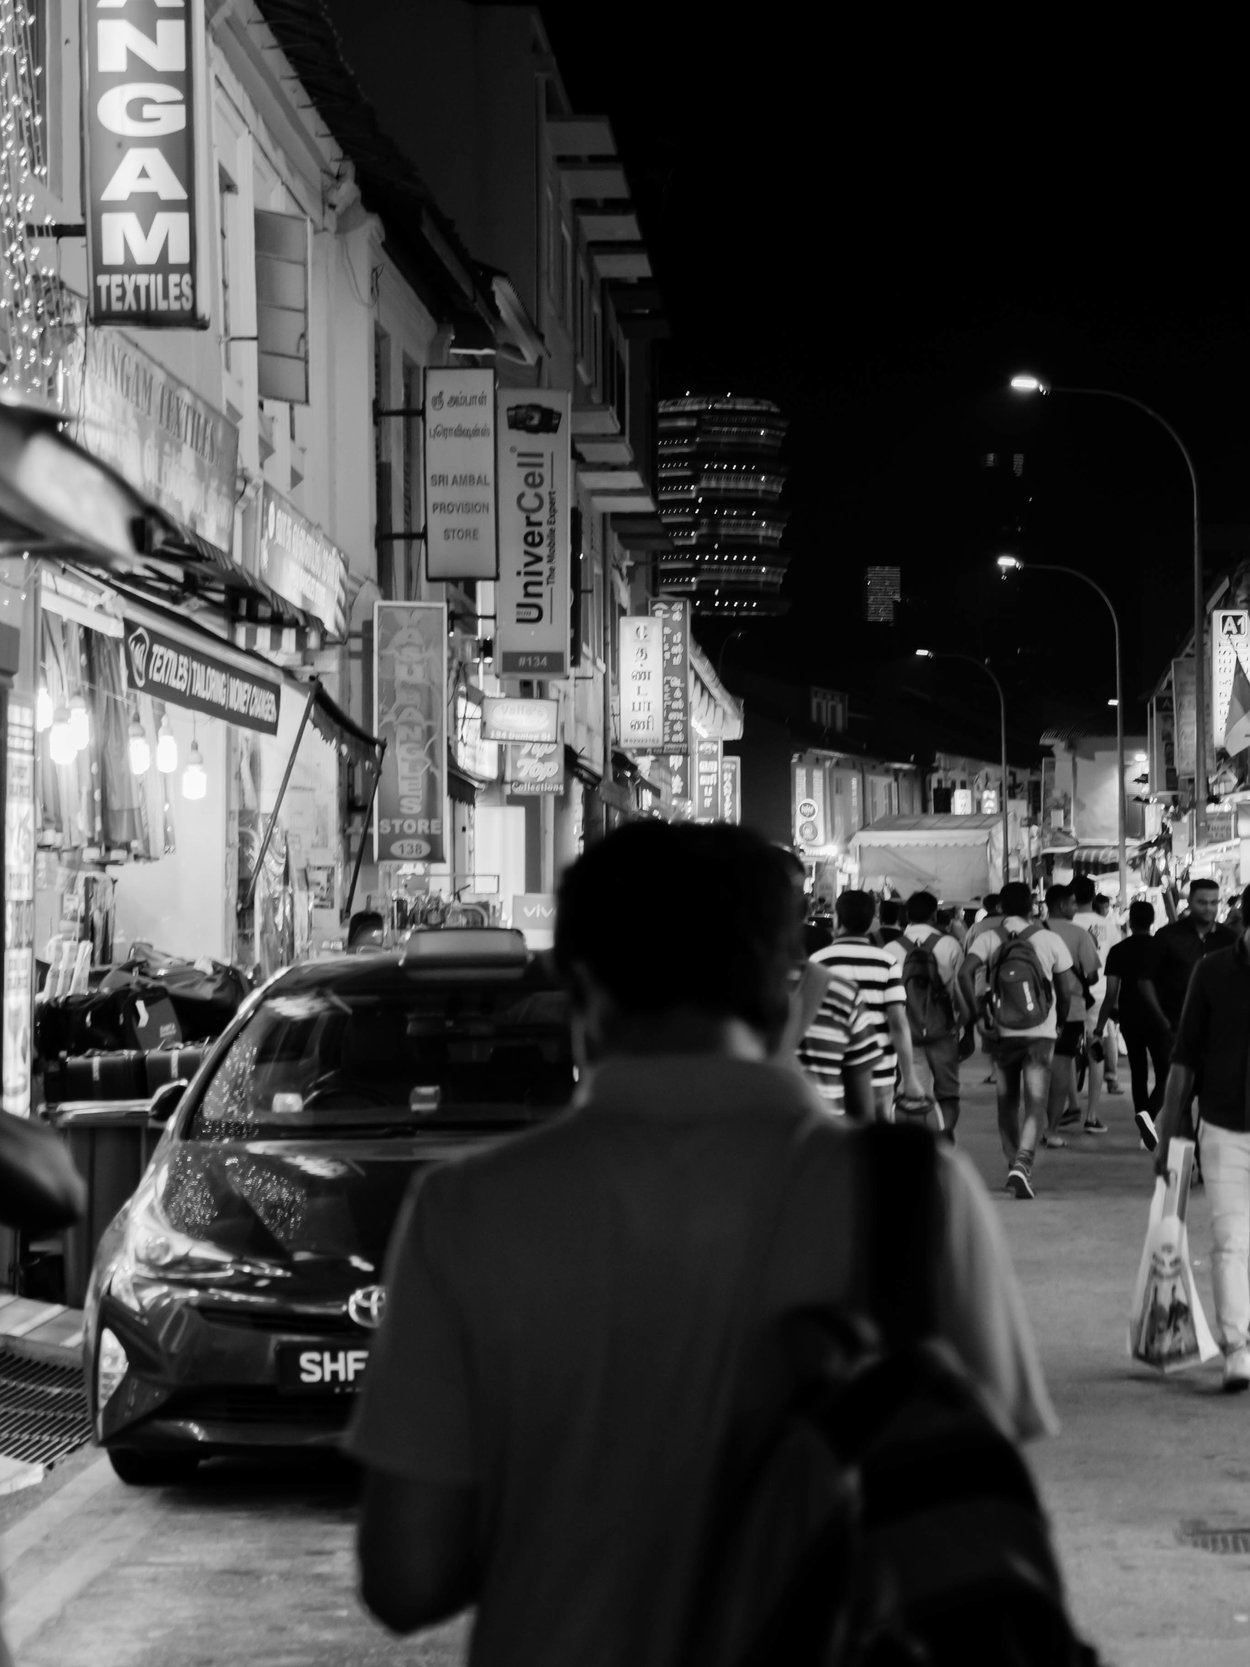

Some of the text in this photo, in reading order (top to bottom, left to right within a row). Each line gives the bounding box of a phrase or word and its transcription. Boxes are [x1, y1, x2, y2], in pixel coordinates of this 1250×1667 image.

[97, 0, 190, 266] NGAM
[96, 274, 193, 311] TEXTILES
[157, 381, 217, 465] TEXTILES
[430, 473, 490, 487] SRI AMBAL
[431, 501, 490, 515] PROVISION
[545, 489, 558, 526] Expert
[443, 528, 480, 541] STORE
[516, 451, 545, 625] UniverCell
[1223, 614, 1246, 635] A1
[517, 655, 548, 668] #134
[149, 643, 189, 693] TEXTILES
[191, 660, 227, 707] TAILORING
[516, 757, 559, 783] Top
[511, 781, 565, 794] Collections
[378, 818, 442, 835] STORE
[397, 841, 423, 856] 138
[523, 903, 555, 919] viv
